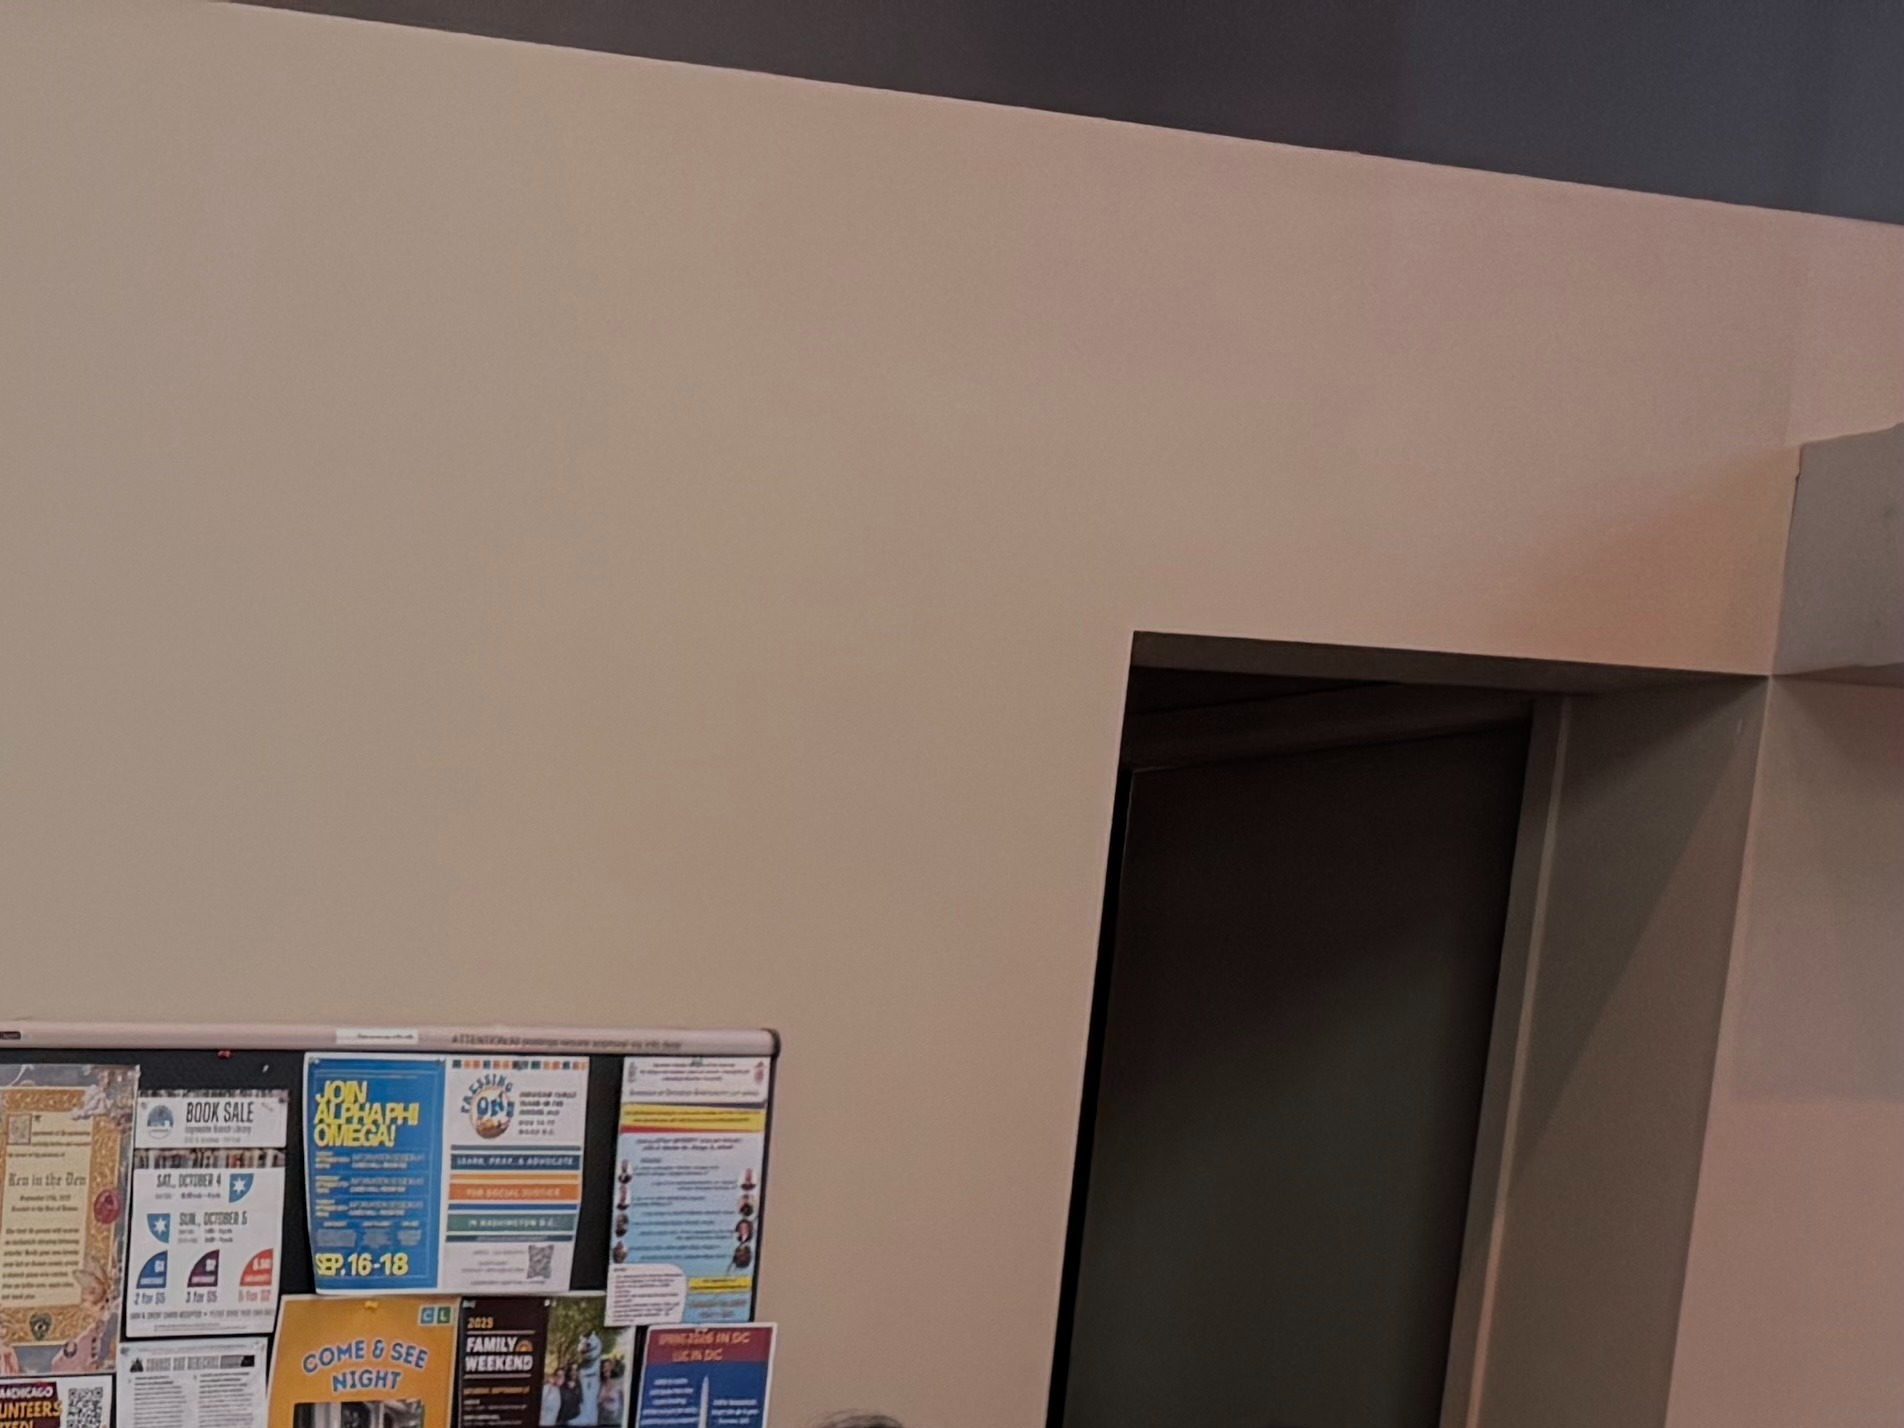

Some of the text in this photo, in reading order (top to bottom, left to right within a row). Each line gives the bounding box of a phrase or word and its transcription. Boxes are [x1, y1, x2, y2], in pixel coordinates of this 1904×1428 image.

[314, 1080, 367, 1104] JOIN
[460, 1073, 514, 1115] PRESSING
[185, 1101, 254, 1123] BOOK SALE
[313, 1102, 420, 1126] ALPHA PHI
[313, 1124, 396, 1148] OMEGA!
[32, 1172, 42, 1187] in
[45, 1172, 62, 1187] the
[178, 1173, 214, 1188] OCTOBER
[215, 1173, 222, 1187] 4
[486, 1188, 520, 1198] SOCIAL
[203, 1212, 239, 1226] OCTOBER
[347, 1252, 409, 1277] 16-18
[142, 1293, 153, 1304] for
[193, 1291, 205, 1303] for
[465, 1335, 518, 1353] FAMILY
[732, 1331, 751, 1343] DC
[303, 1338, 429, 1374] COME & SEE
[464, 1355, 534, 1372] WEEKEND
[331, 1369, 403, 1393] NIGHT
